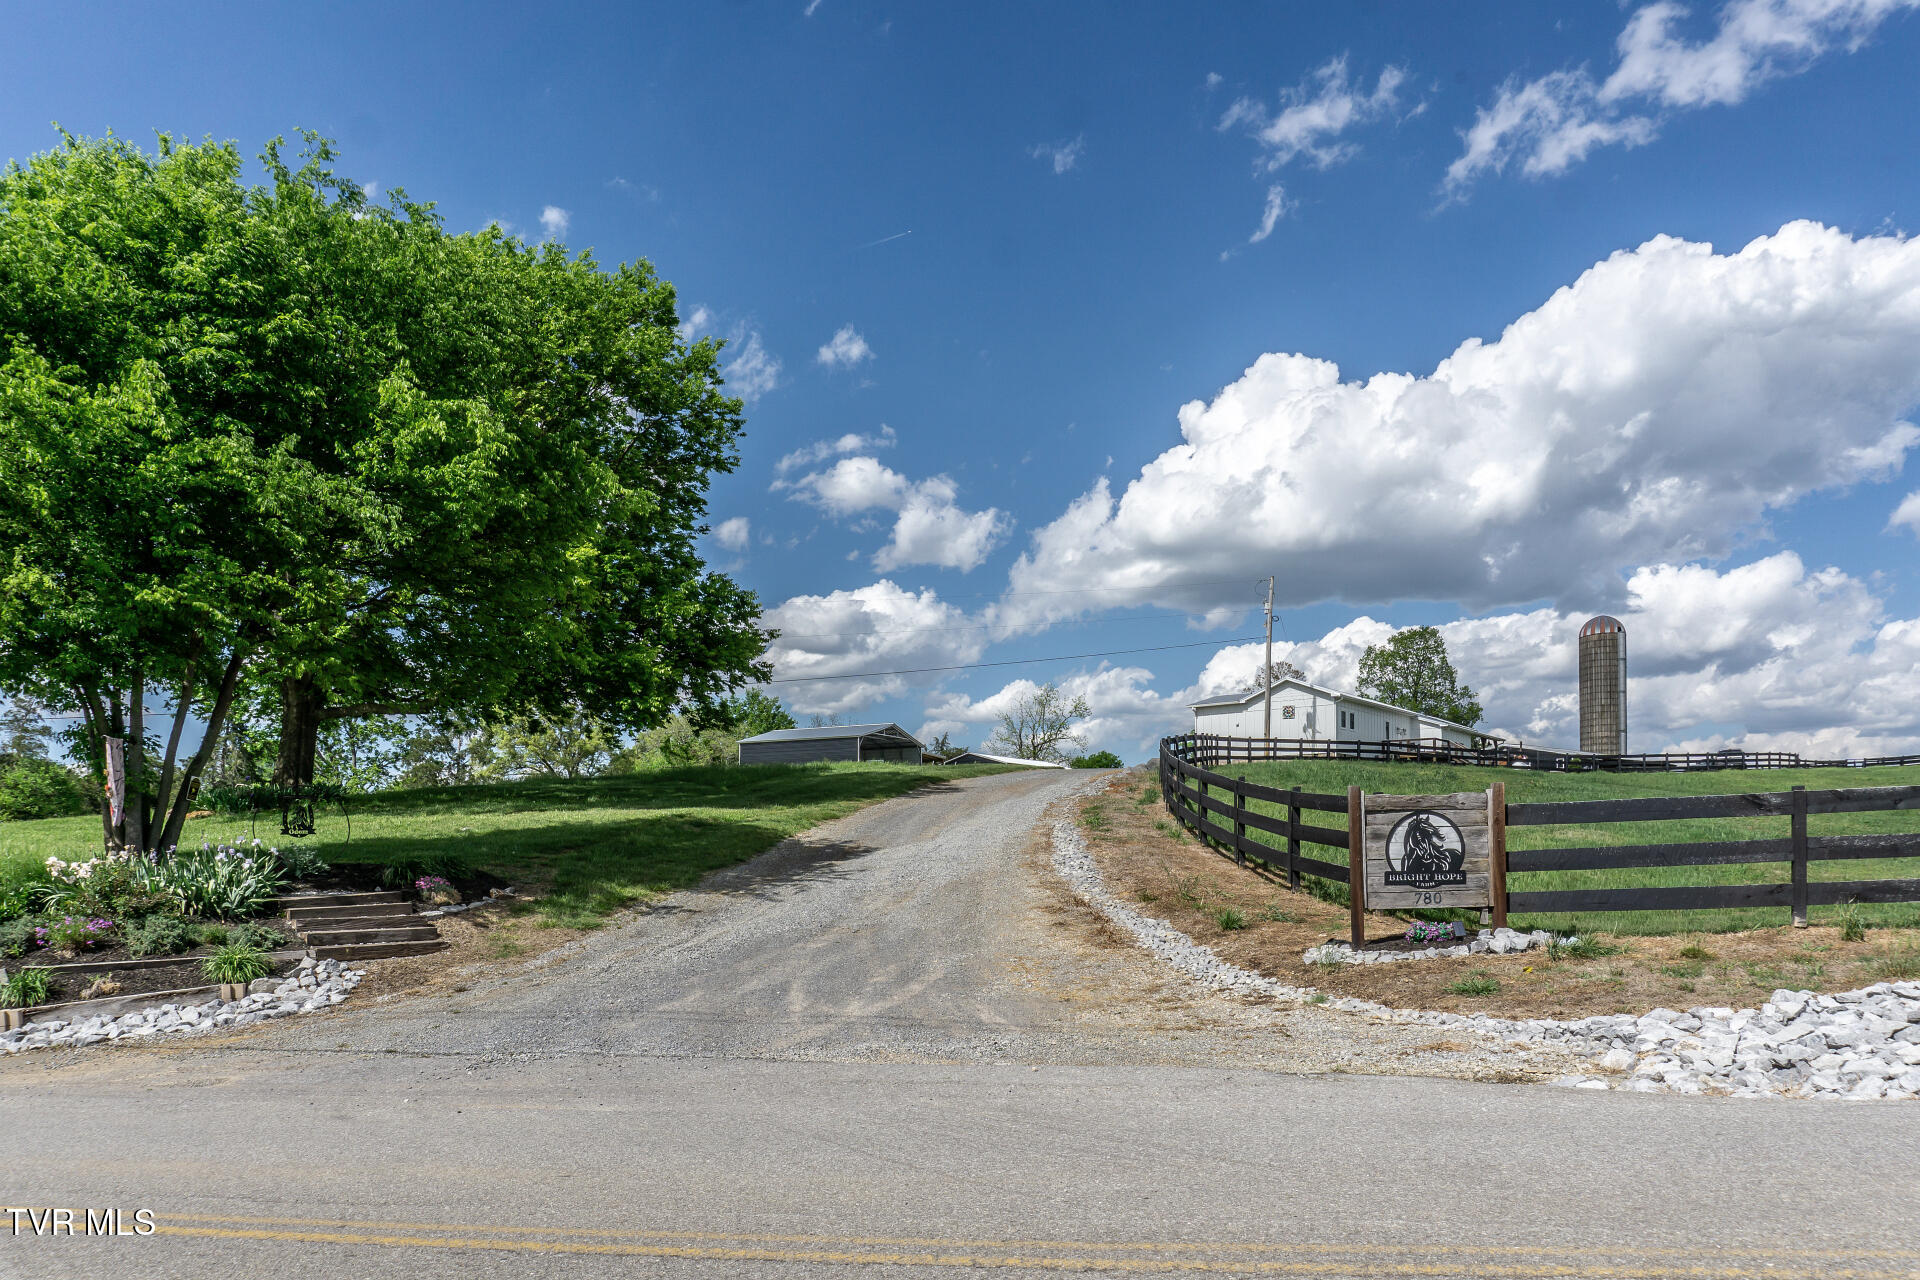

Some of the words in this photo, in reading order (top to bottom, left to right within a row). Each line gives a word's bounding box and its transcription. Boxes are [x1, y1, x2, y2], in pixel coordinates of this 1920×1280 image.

[1389, 873, 1430, 881] BRIGHT
[1434, 873, 1463, 881] HOPE
[1415, 892, 1442, 904] 780
